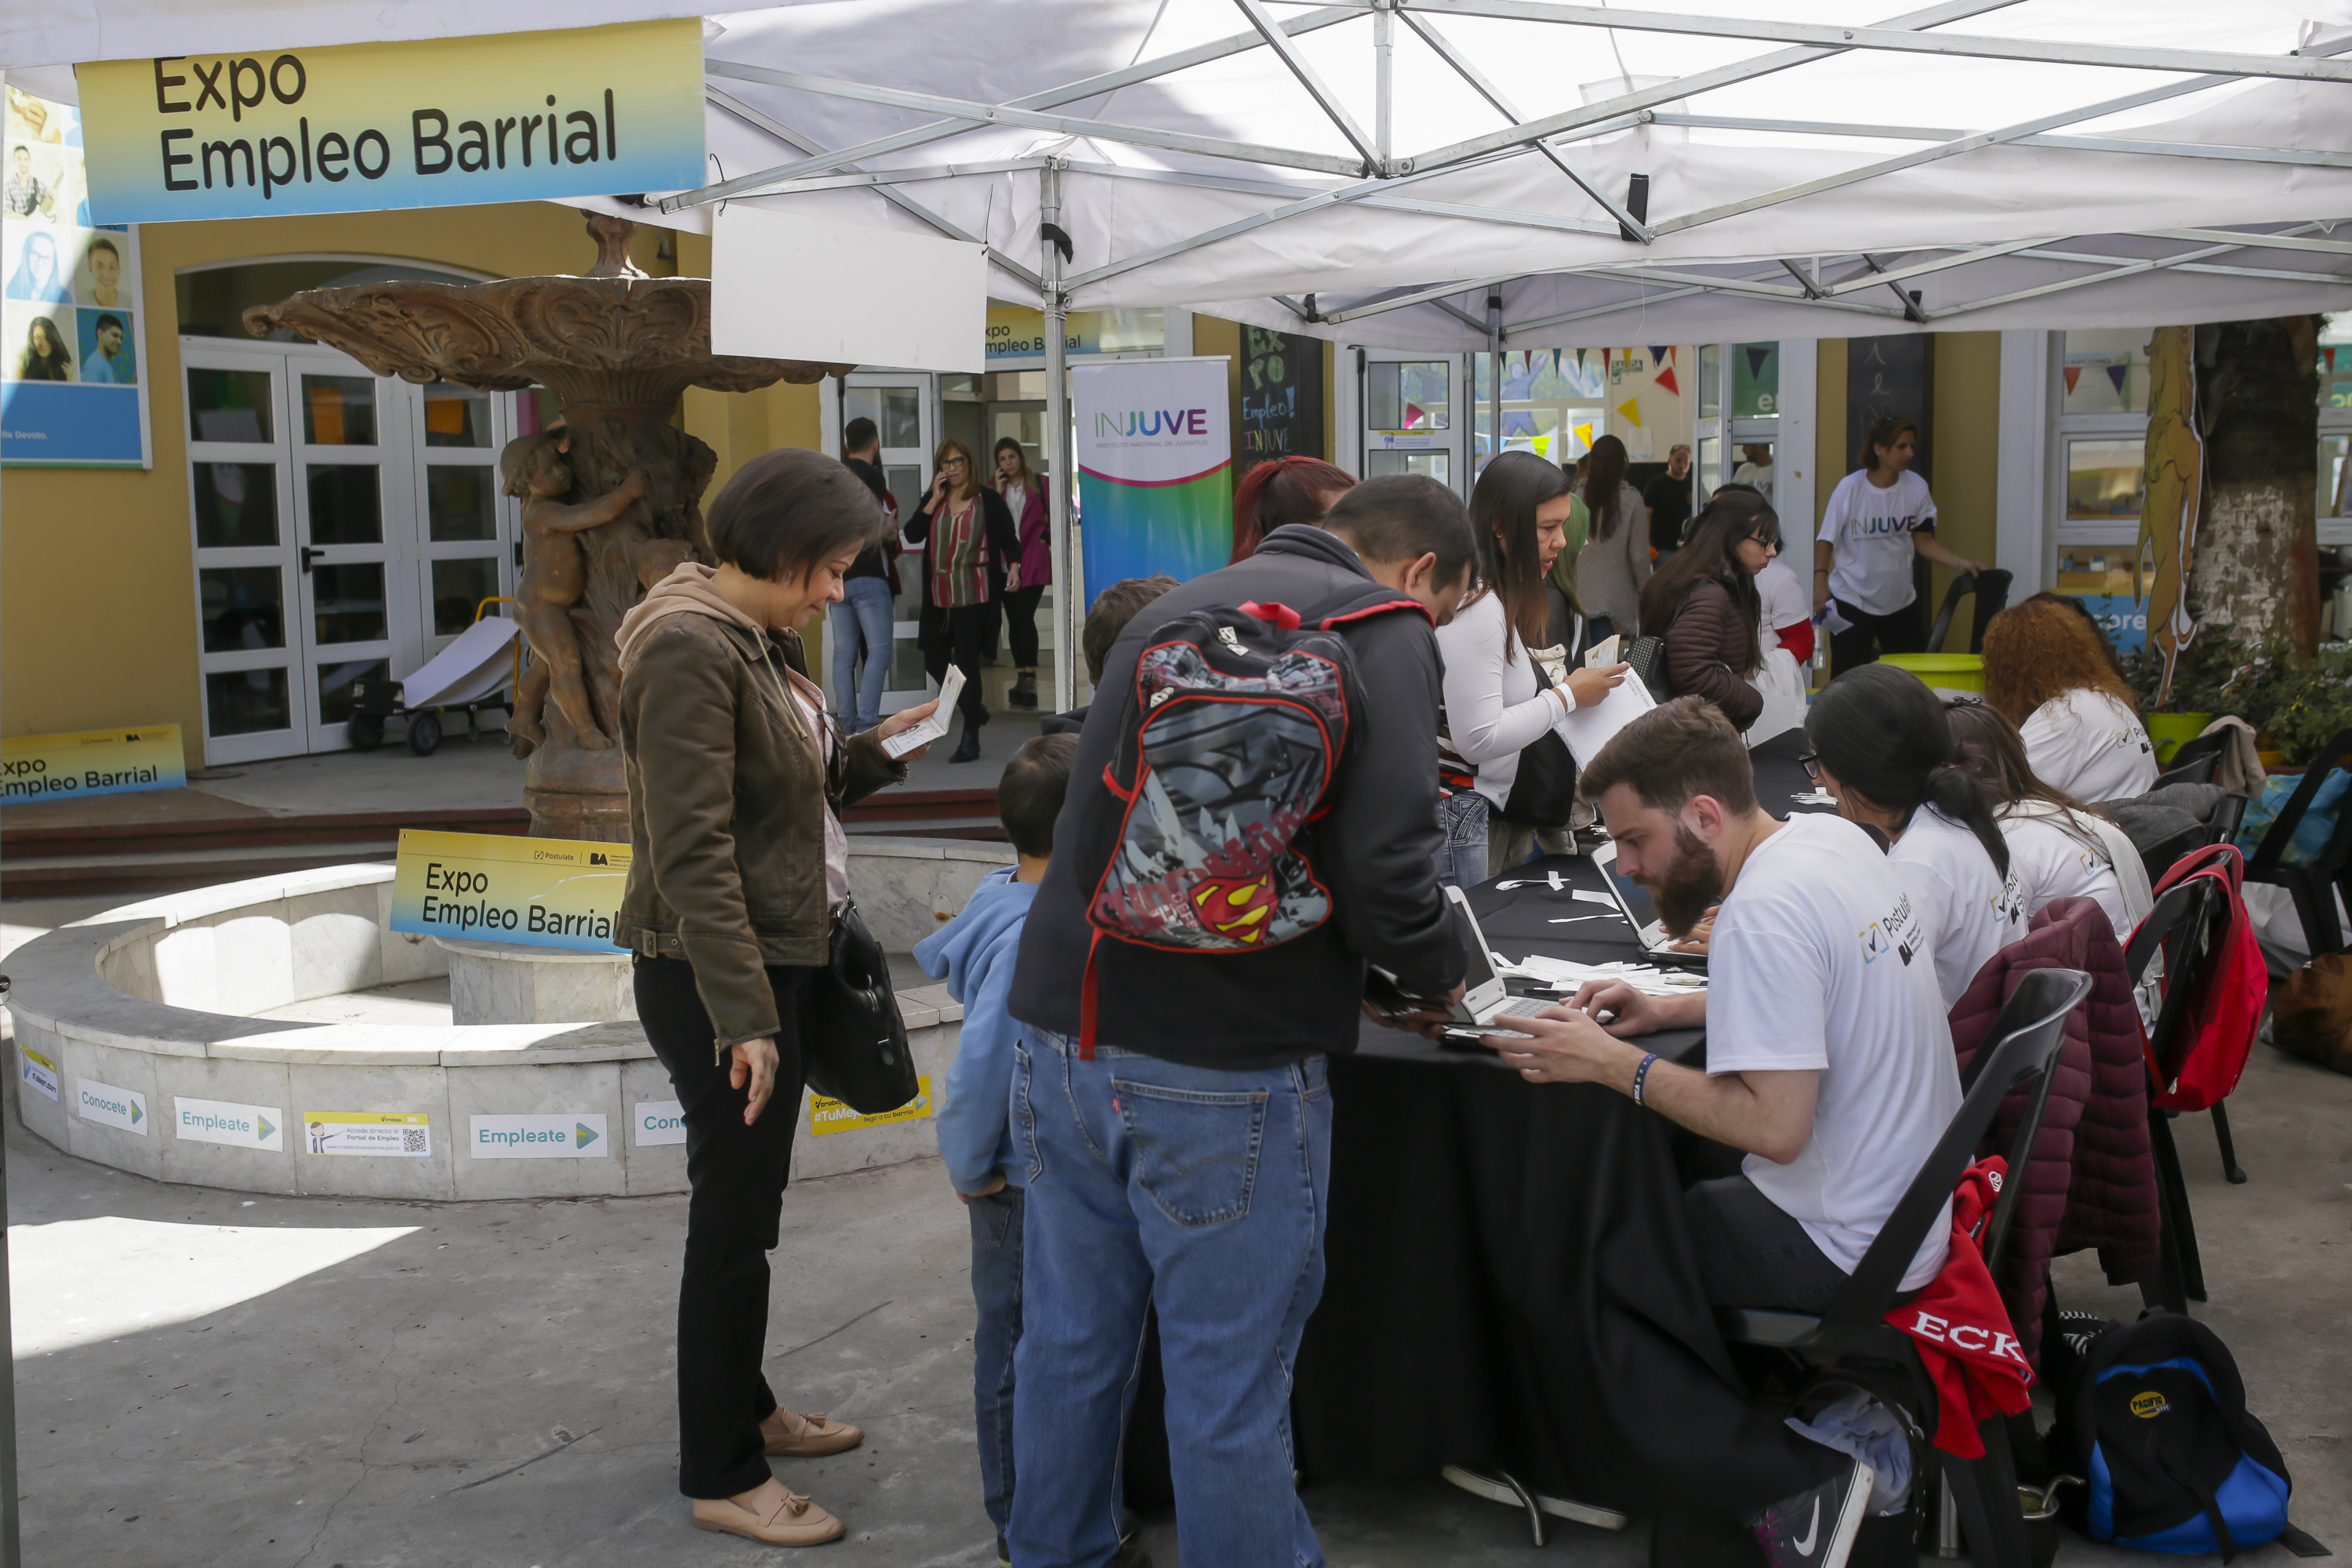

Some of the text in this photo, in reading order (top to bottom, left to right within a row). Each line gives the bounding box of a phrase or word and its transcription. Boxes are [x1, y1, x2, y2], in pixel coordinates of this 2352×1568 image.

[154, 54, 307, 122] Expo
[161, 88, 616, 200] Empleo Barrial
[985, 325, 1010, 339] xpo
[985, 335, 1081, 354] mpleo Bial
[1612, 360, 1642, 372] SALDA
[1095, 408, 1208, 437] INJUVE
[1243, 428, 1292, 454] INJUVE
[1851, 516, 1916, 535] INJUVE
[0, 759, 46, 778] xpo
[0, 764, 158, 797] mpleo Barrial
[545, 852, 574, 861] Postulate
[426, 862, 488, 897] Expo
[423, 899, 619, 939] Empleo Barrial
[82, 1091, 127, 1116] Conocete
[821, 1099, 843, 1108] trabaj
[183, 1111, 250, 1132] Empleate
[863, 1115, 877, 1123] llegó
[892, 1109, 914, 1118] barrio
[479, 1127, 566, 1147] Empleate
[1910, 1311, 2026, 1364] ECK
[2132, 1396, 2163, 1410] PACIFIC
